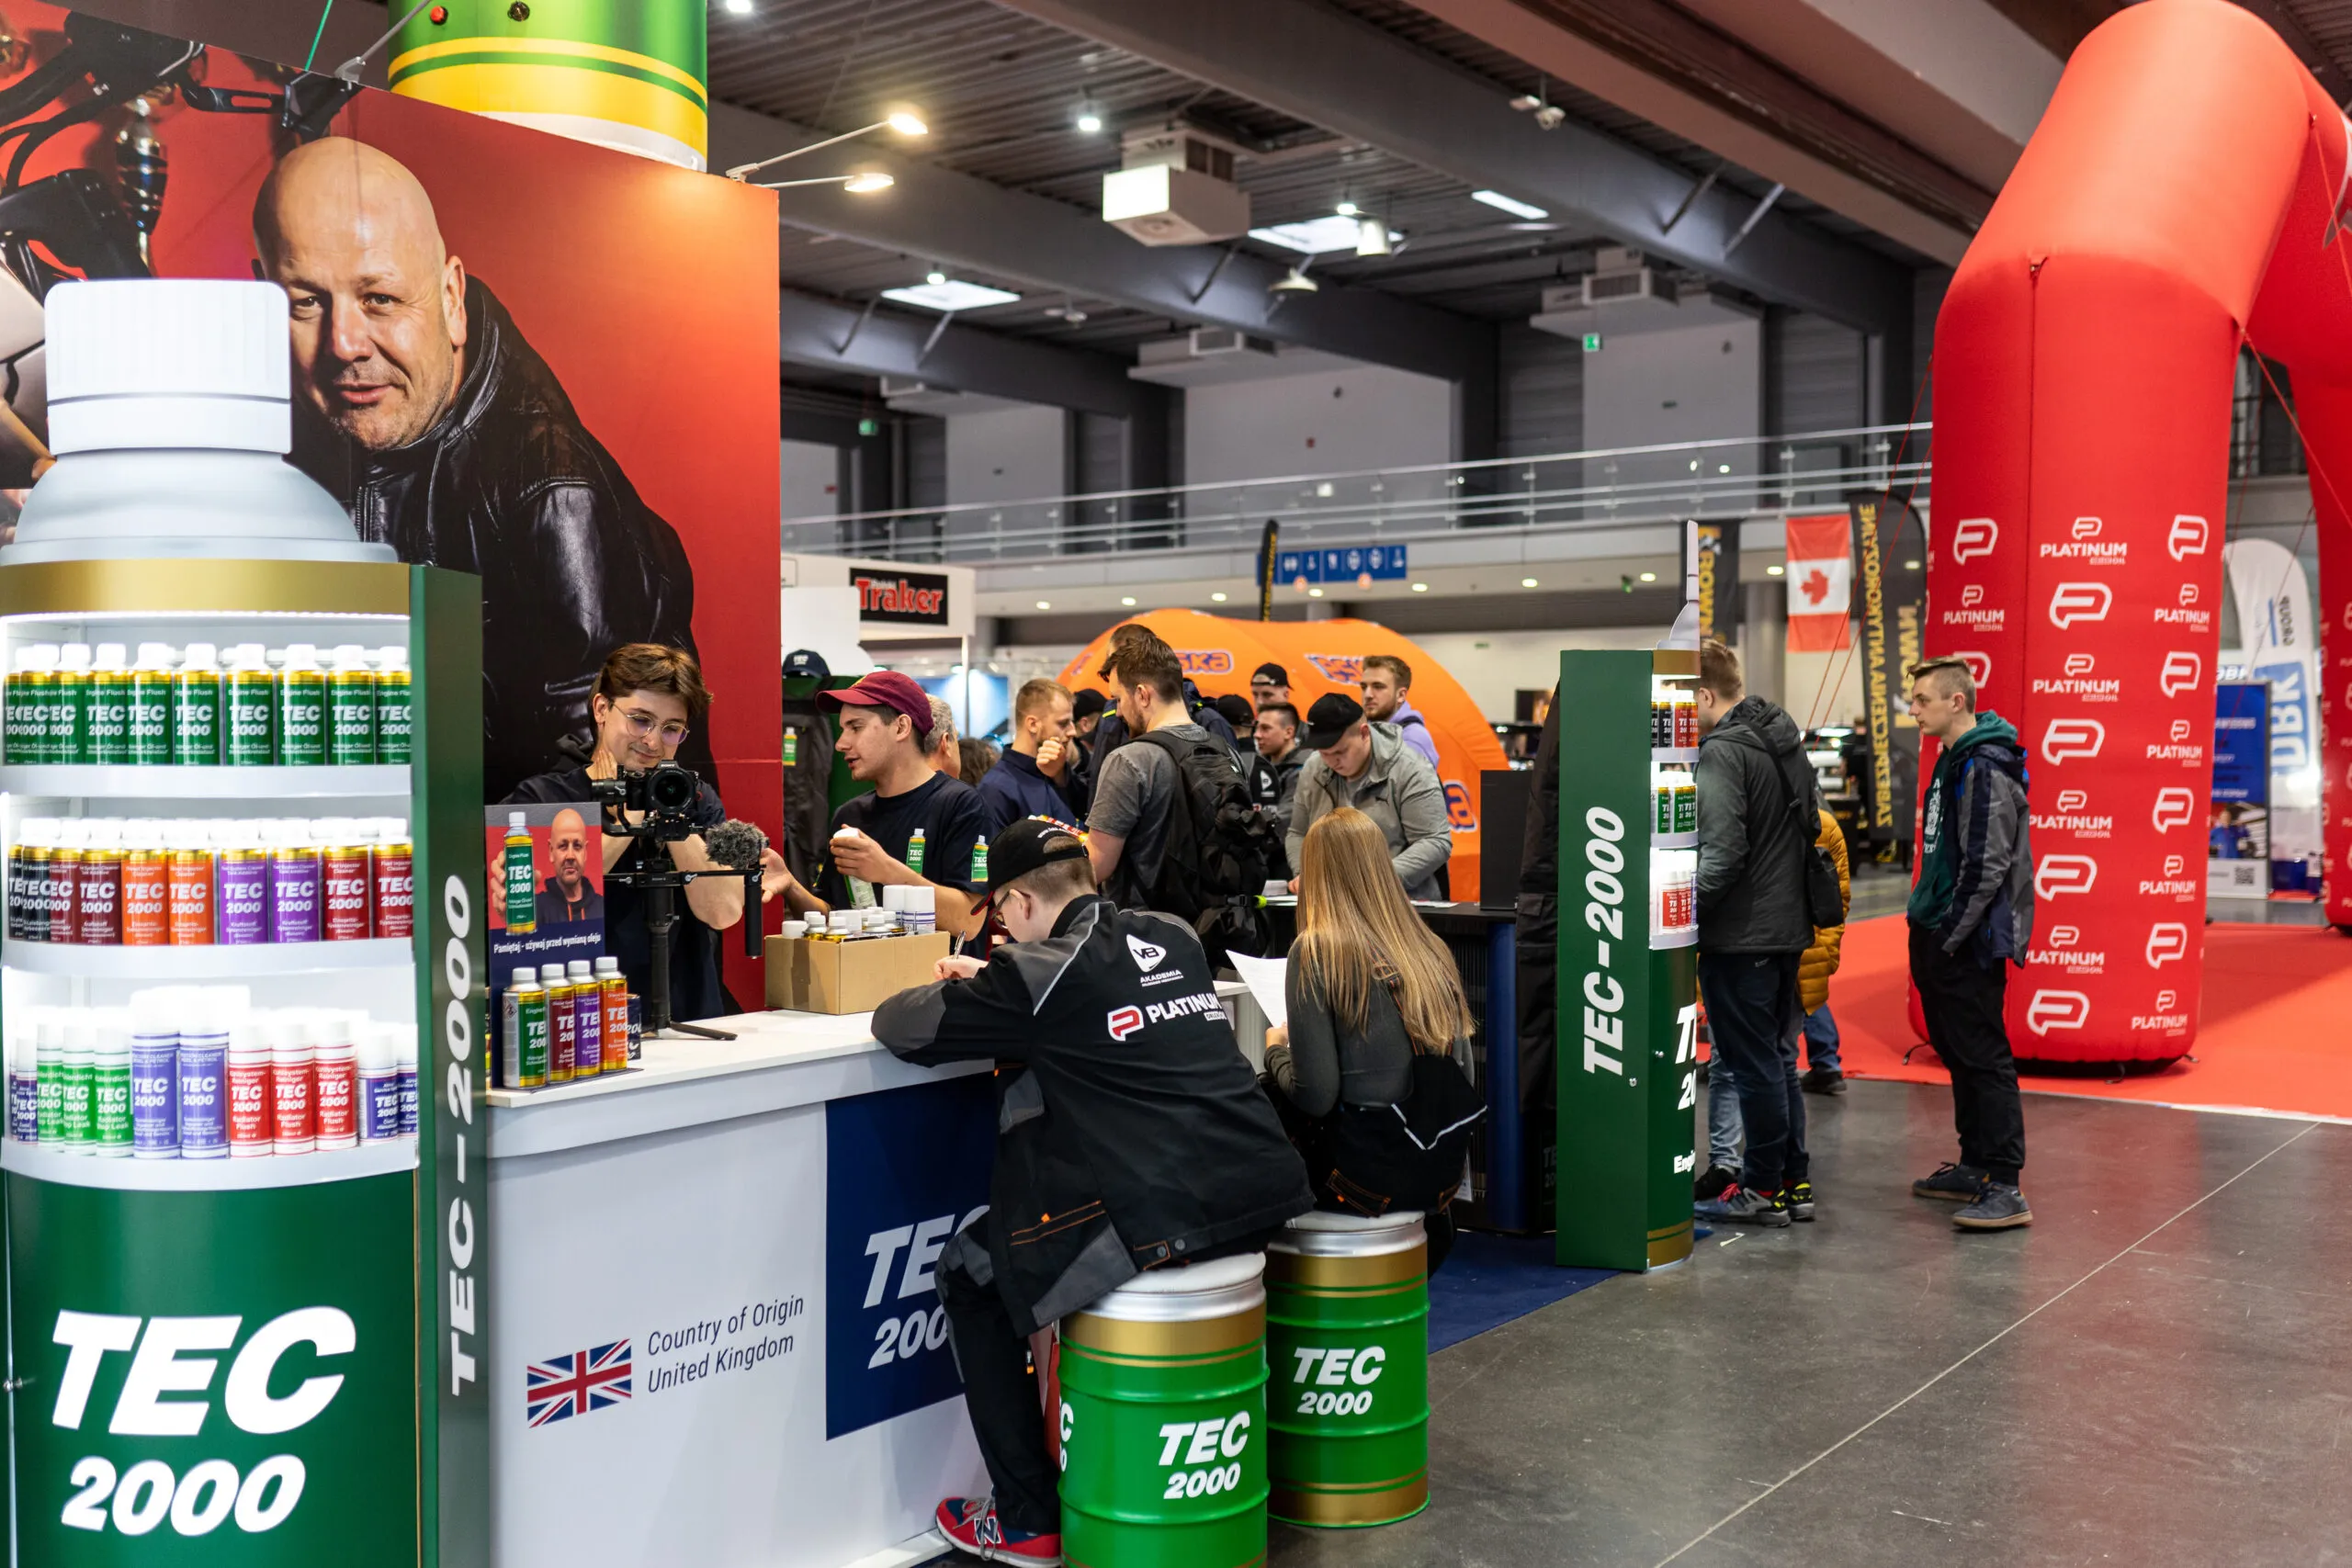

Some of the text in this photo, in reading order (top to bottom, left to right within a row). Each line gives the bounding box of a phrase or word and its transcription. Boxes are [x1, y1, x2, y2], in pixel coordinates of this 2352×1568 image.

[2040, 543, 2127, 558] PLATINUM
[854, 577, 944, 615] Traker
[1943, 609, 2005, 625] PLATINUM
[2154, 609, 2210, 624] PLATINUM
[2032, 679, 2120, 694] PLATINUM
[87, 705, 125, 721] TEC
[128, 705, 165, 721] TEC
[175, 705, 212, 721] TEC
[230, 705, 268, 721] TEC
[281, 705, 320, 721] TEC
[333, 705, 370, 721] TEC
[89, 724, 123, 735] 2000
[130, 724, 164, 735] 2000
[176, 724, 210, 735] 2000
[232, 724, 266, 735] 2000
[284, 724, 318, 735] 2000
[334, 724, 368, 735] 2000
[2147, 745, 2202, 760] PLATINUM
[2029, 816, 2112, 829] PLATINUM
[508, 864, 531, 880] TEC
[51, 881, 74, 897] EC
[80, 883, 115, 898] TEC
[126, 884, 164, 899] TEC
[170, 884, 206, 899] TEC
[224, 883, 263, 899] TEC
[276, 882, 314, 897] TEC
[326, 879, 365, 895] TEC
[379, 876, 413, 893] TEC
[510, 882, 531, 893] 2000
[2139, 882, 2196, 895] PLATINUM
[81, 902, 113, 913] 2000
[128, 902, 162, 913] 2000
[172, 902, 204, 913] 2000
[226, 902, 261, 913] 2000
[277, 900, 312, 911] 2000
[329, 898, 363, 909] 2000
[381, 895, 413, 907] 2000
[494, 941, 520, 953] Pamiętaj
[547, 937, 562, 950] przed
[588, 932, 601, 944] oleju
[1140, 970, 1182, 983] AKADEMIA
[607, 1007, 628, 1021] TE
[1145, 993, 1222, 1023] PLATINUM
[558, 1015, 575, 1030] TE
[580, 1011, 600, 1025] TE
[2132, 1014, 2188, 1031] PLATINUM
[526, 1021, 546, 1036] TE
[582, 1027, 600, 1038] 200
[610, 1022, 628, 1032] 200
[134, 1078, 168, 1093] TEC
[182, 1077, 217, 1093] TEC
[276, 1084, 307, 1099] TEC
[319, 1080, 349, 1095] TEC
[96, 1088, 127, 1102] TEC
[184, 1095, 215, 1106] 2000
[232, 1086, 263, 1100] TEC
[98, 1103, 126, 1113] 2000
[135, 1095, 165, 1107] 2000
[233, 1102, 261, 1111] 2000
[277, 1100, 305, 1110] 2000
[320, 1097, 349, 1107] 2000
[863, 1205, 989, 1309] TE
[648, 1295, 805, 1357] Country of Origin
[867, 1308, 949, 1371] 200
[648, 1332, 795, 1393] United Kingdom
[1294, 1346, 1385, 1386] TEC
[52, 1306, 356, 1436] TEC
[1297, 1391, 1373, 1416] 2000
[1158, 1411, 1250, 1466] TEC
[1163, 1462, 1240, 1499] 2000
[61, 1453, 307, 1536] 2000
